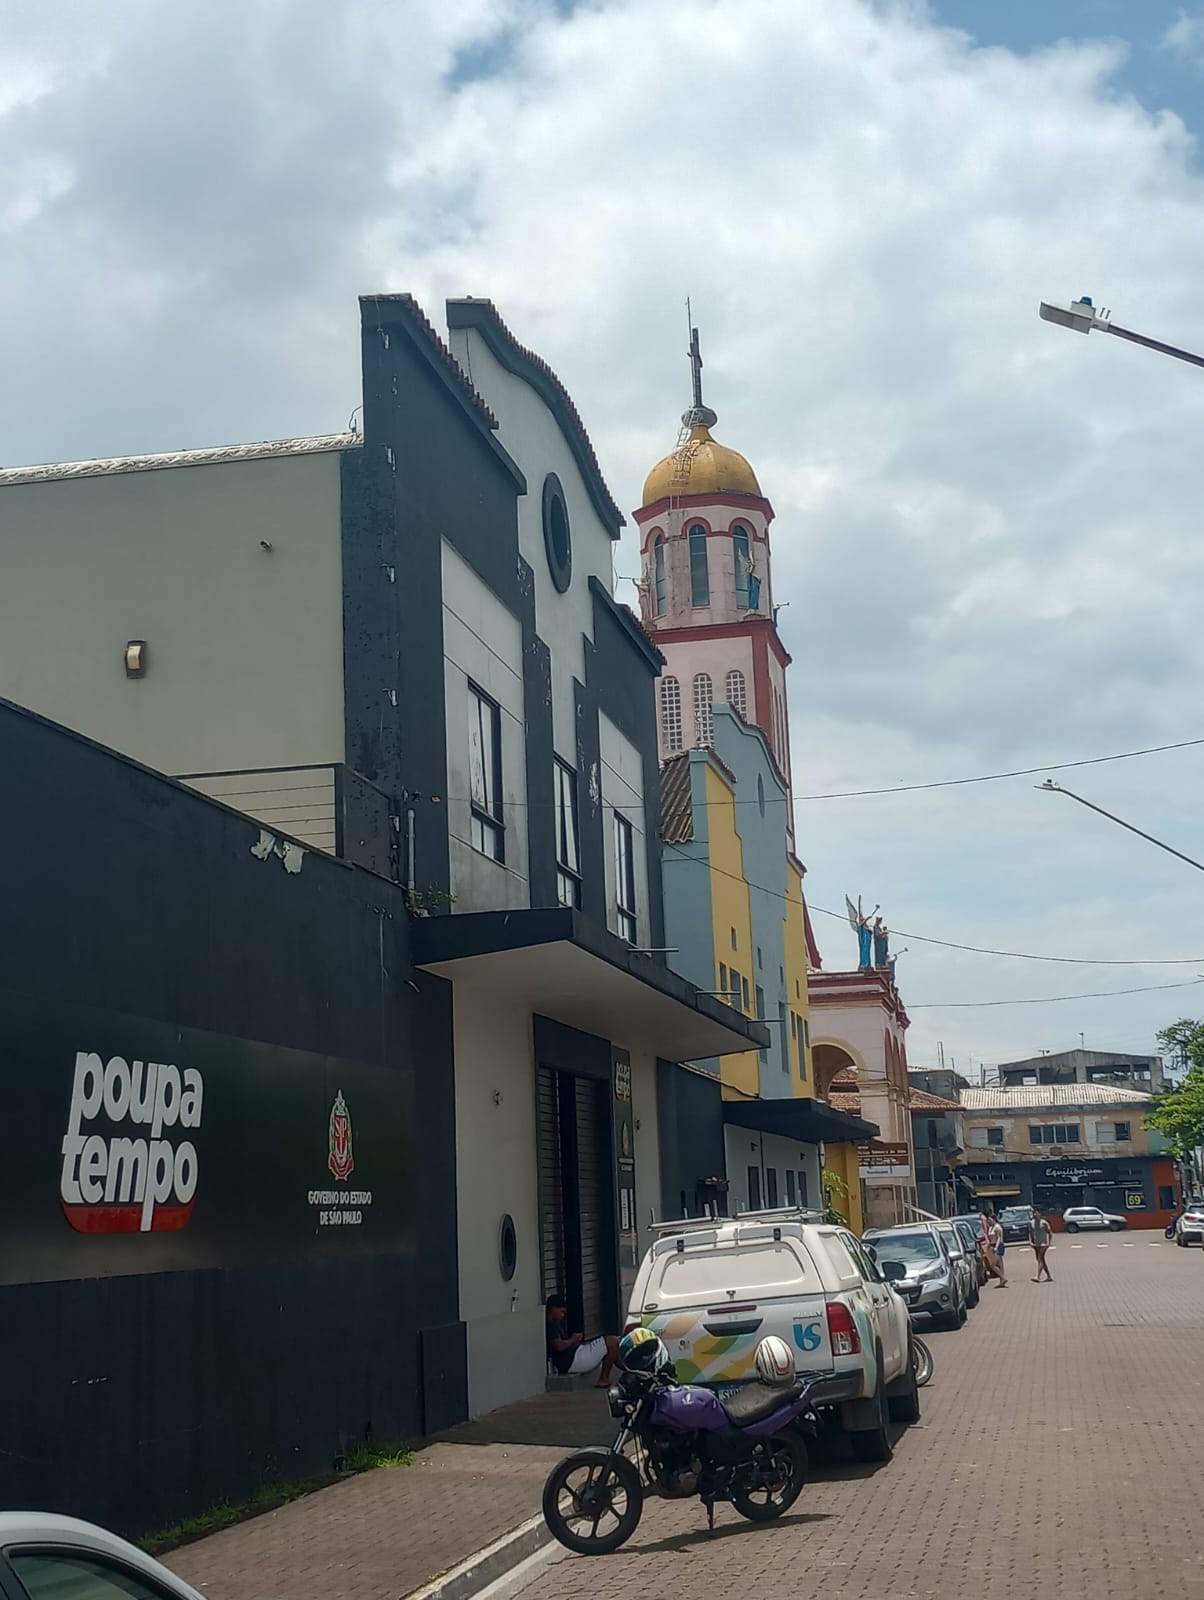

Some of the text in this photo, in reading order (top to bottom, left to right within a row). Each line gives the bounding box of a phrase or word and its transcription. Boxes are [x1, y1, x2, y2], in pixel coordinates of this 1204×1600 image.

[67, 1051, 204, 1139] poupa
[60, 1134, 199, 1232] tempo
[308, 1190, 372, 1205] GOVERNO DO ESTADO
[319, 1211, 329, 1225] DE
[342, 1211, 362, 1225] PAULO
